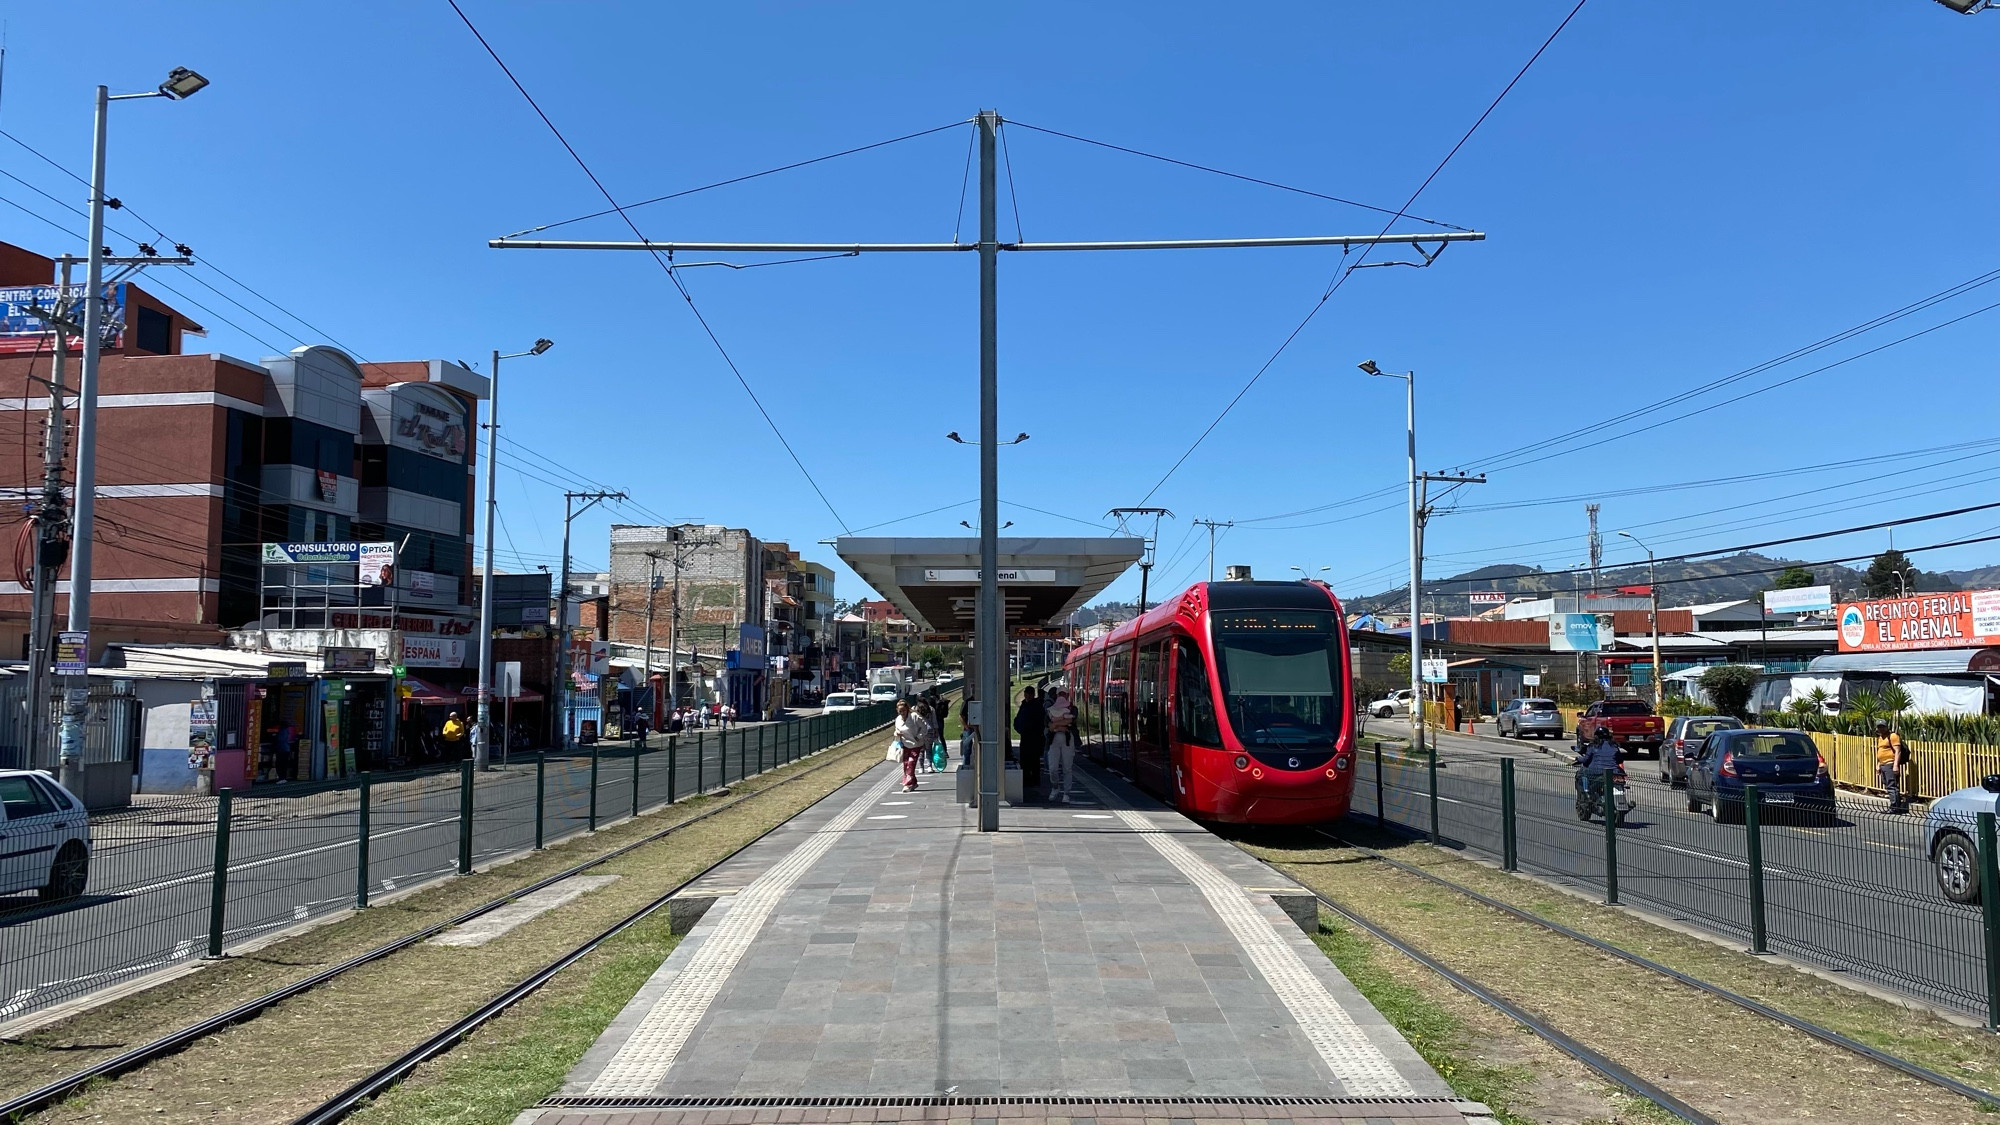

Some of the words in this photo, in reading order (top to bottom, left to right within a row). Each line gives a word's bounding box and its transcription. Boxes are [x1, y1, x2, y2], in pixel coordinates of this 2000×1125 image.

[0, 289, 32, 302] ENTRO
[288, 544, 356, 553] CONSULTORIO
[1472, 592, 1504, 600] TITAN
[1866, 601, 1919, 621] RECINTO
[1924, 596, 1971, 616] FERIAL
[1878, 620, 1896, 642] EL
[1900, 616, 1963, 641] ARENAL
[742, 637, 763, 656] JAHER
[1950, 637, 1986, 646] FABRICANTES
[405, 646, 441, 659] ESPAÑA
